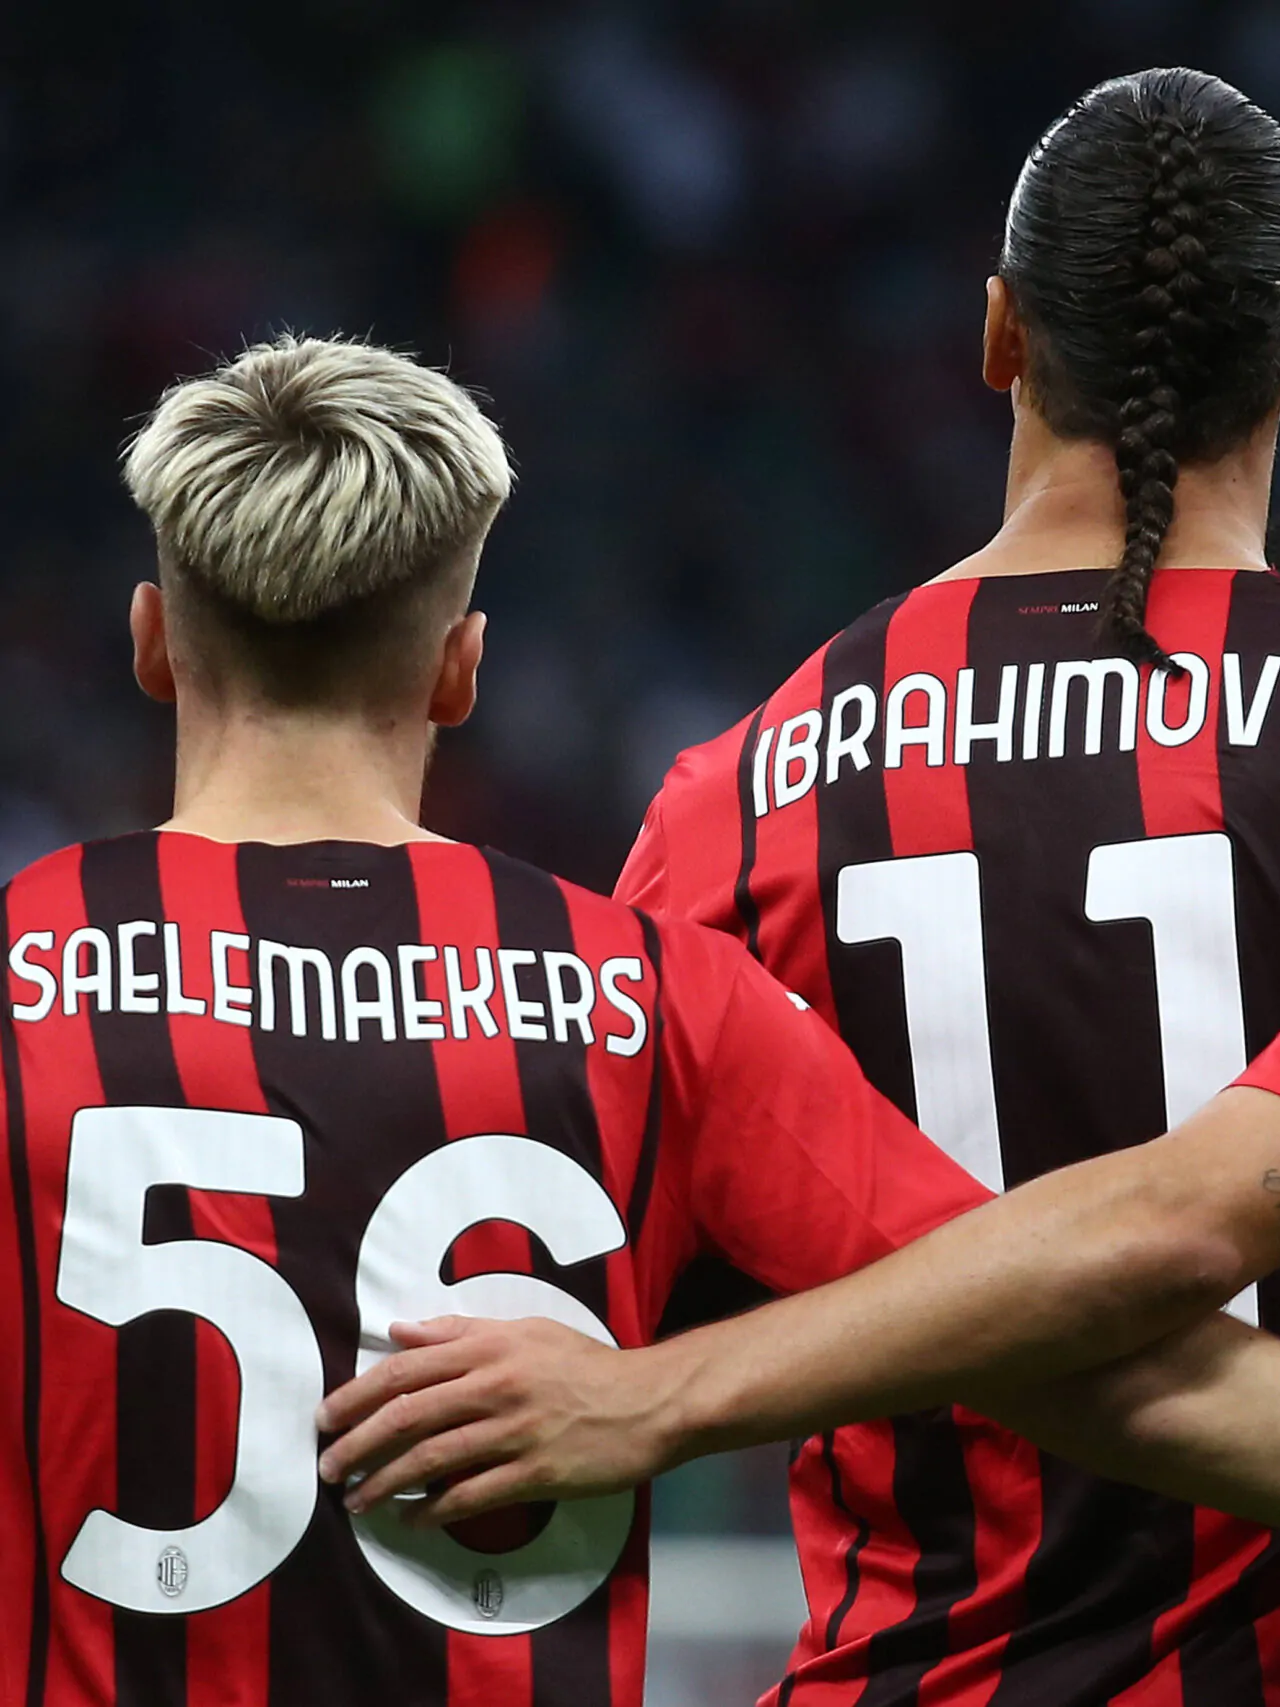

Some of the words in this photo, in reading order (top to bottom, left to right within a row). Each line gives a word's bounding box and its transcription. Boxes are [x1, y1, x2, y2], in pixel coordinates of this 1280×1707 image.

[1060, 602, 1099, 613] MILAN
[330, 879, 369, 889] MILAN
[8, 921, 648, 1058] SAELEMAEKERS
[836, 833, 1261, 1328] 11
[57, 1106, 634, 1635] 56
